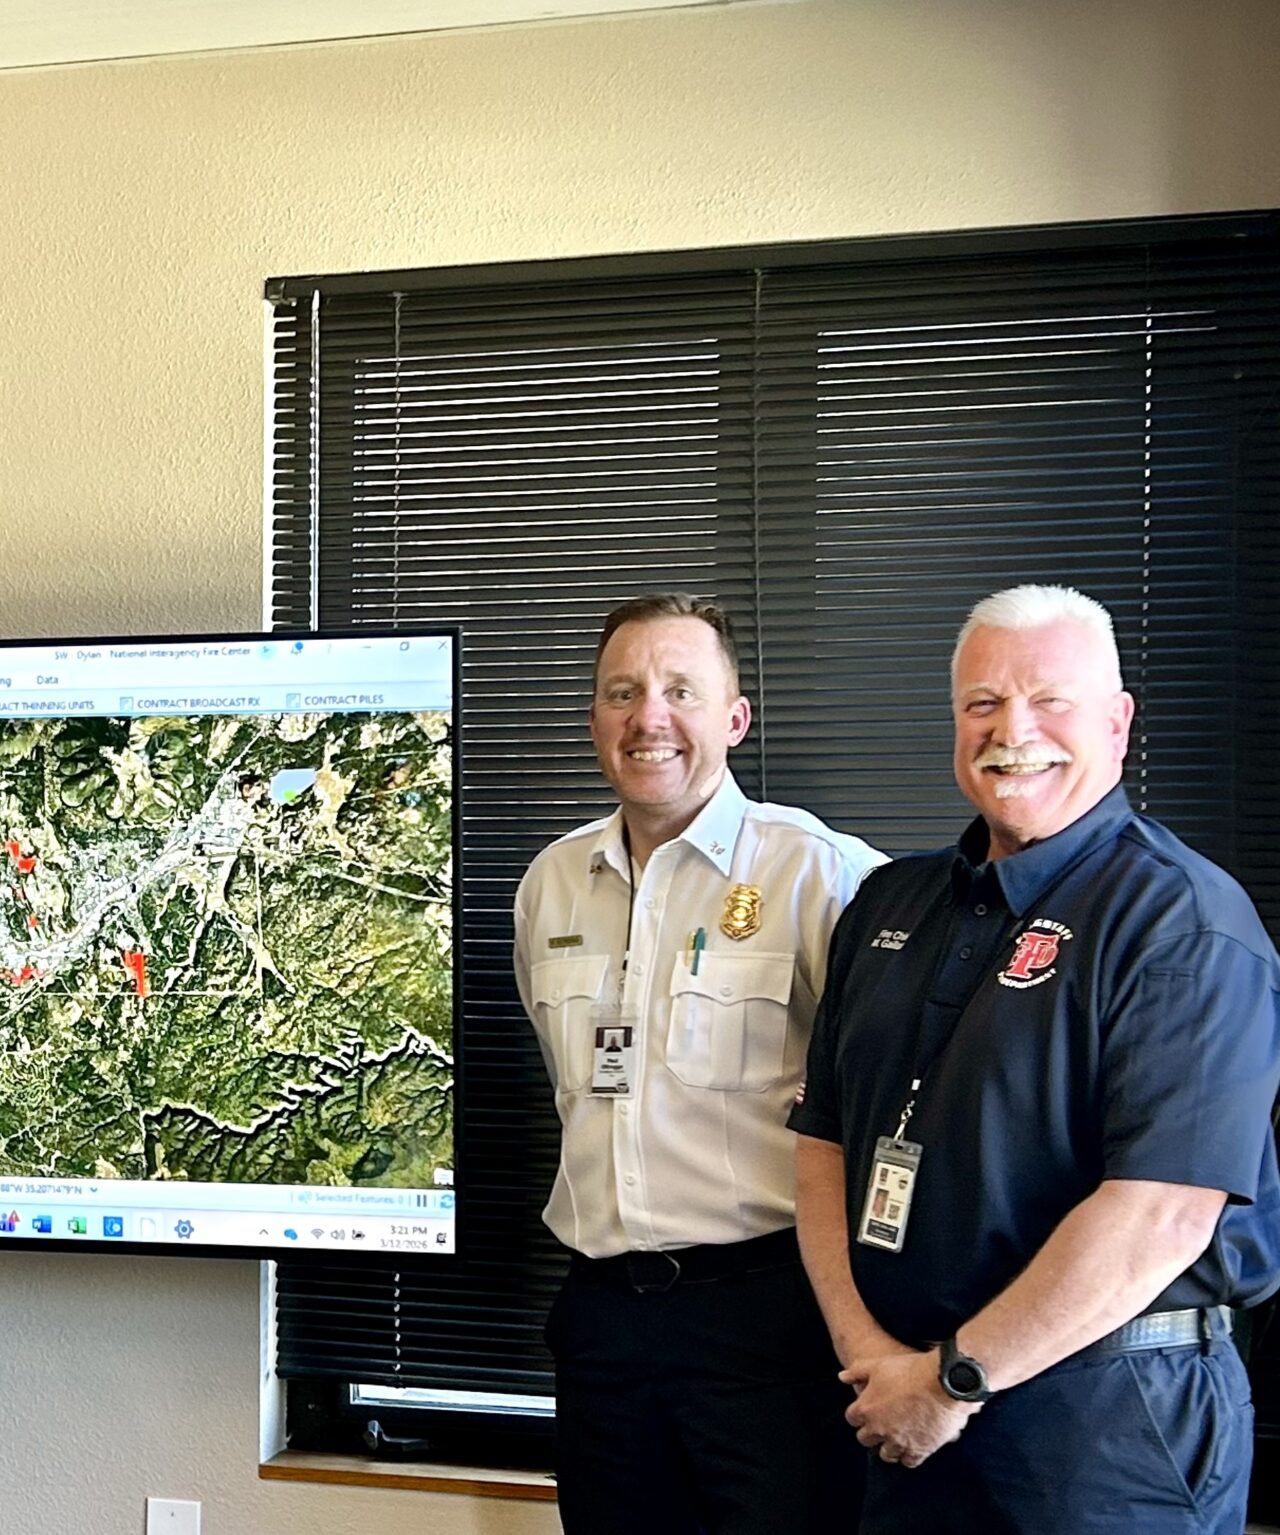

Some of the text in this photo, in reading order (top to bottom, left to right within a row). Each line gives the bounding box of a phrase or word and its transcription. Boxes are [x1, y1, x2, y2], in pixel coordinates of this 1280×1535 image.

[110, 649, 147, 658] National
[149, 648, 200, 660] Interagency
[203, 647, 219, 656] Fire
[221, 646, 251, 656] Center
[36, 675, 59, 685] Data
[21, 701, 67, 711] THINNING
[68, 700, 95, 710] UNITS
[137, 696, 261, 709] CONTRACT BROADCAST RX
[304, 694, 385, 706] CONTRACT PILES
[390, 1225, 428, 1236] 3:21 PM
